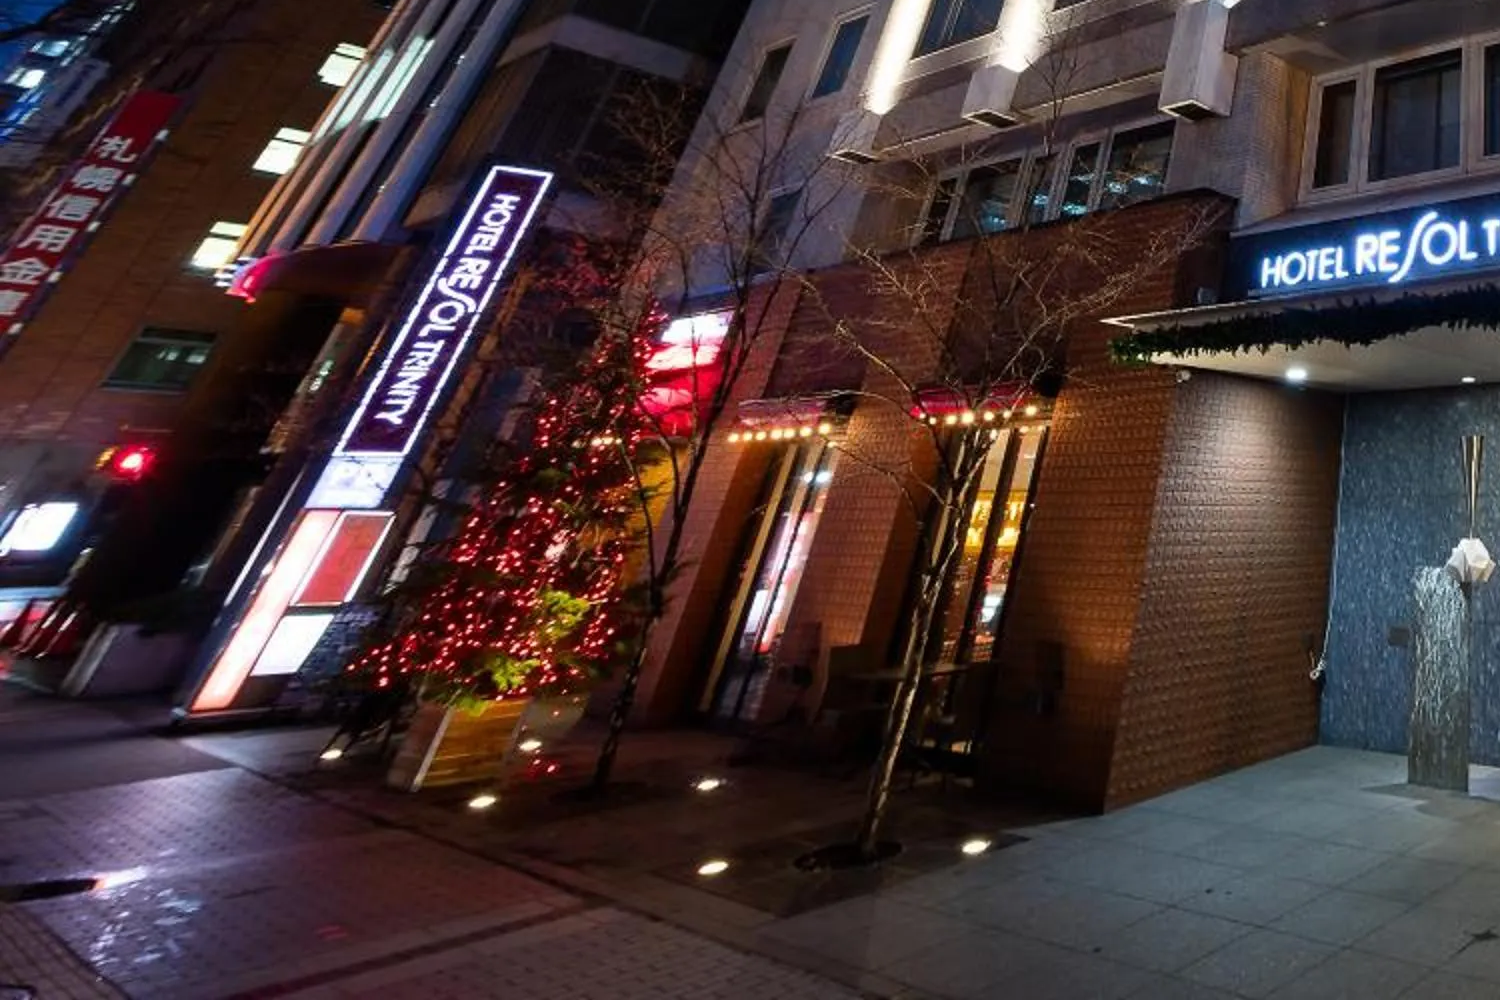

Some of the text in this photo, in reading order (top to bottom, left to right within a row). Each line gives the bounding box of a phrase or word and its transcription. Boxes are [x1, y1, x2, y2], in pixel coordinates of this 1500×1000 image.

[374, 193, 521, 426] HOTEL RESOL TRINITY
[1260, 245, 1349, 289] HOTEL
[1354, 210, 1478, 284] RESOL
